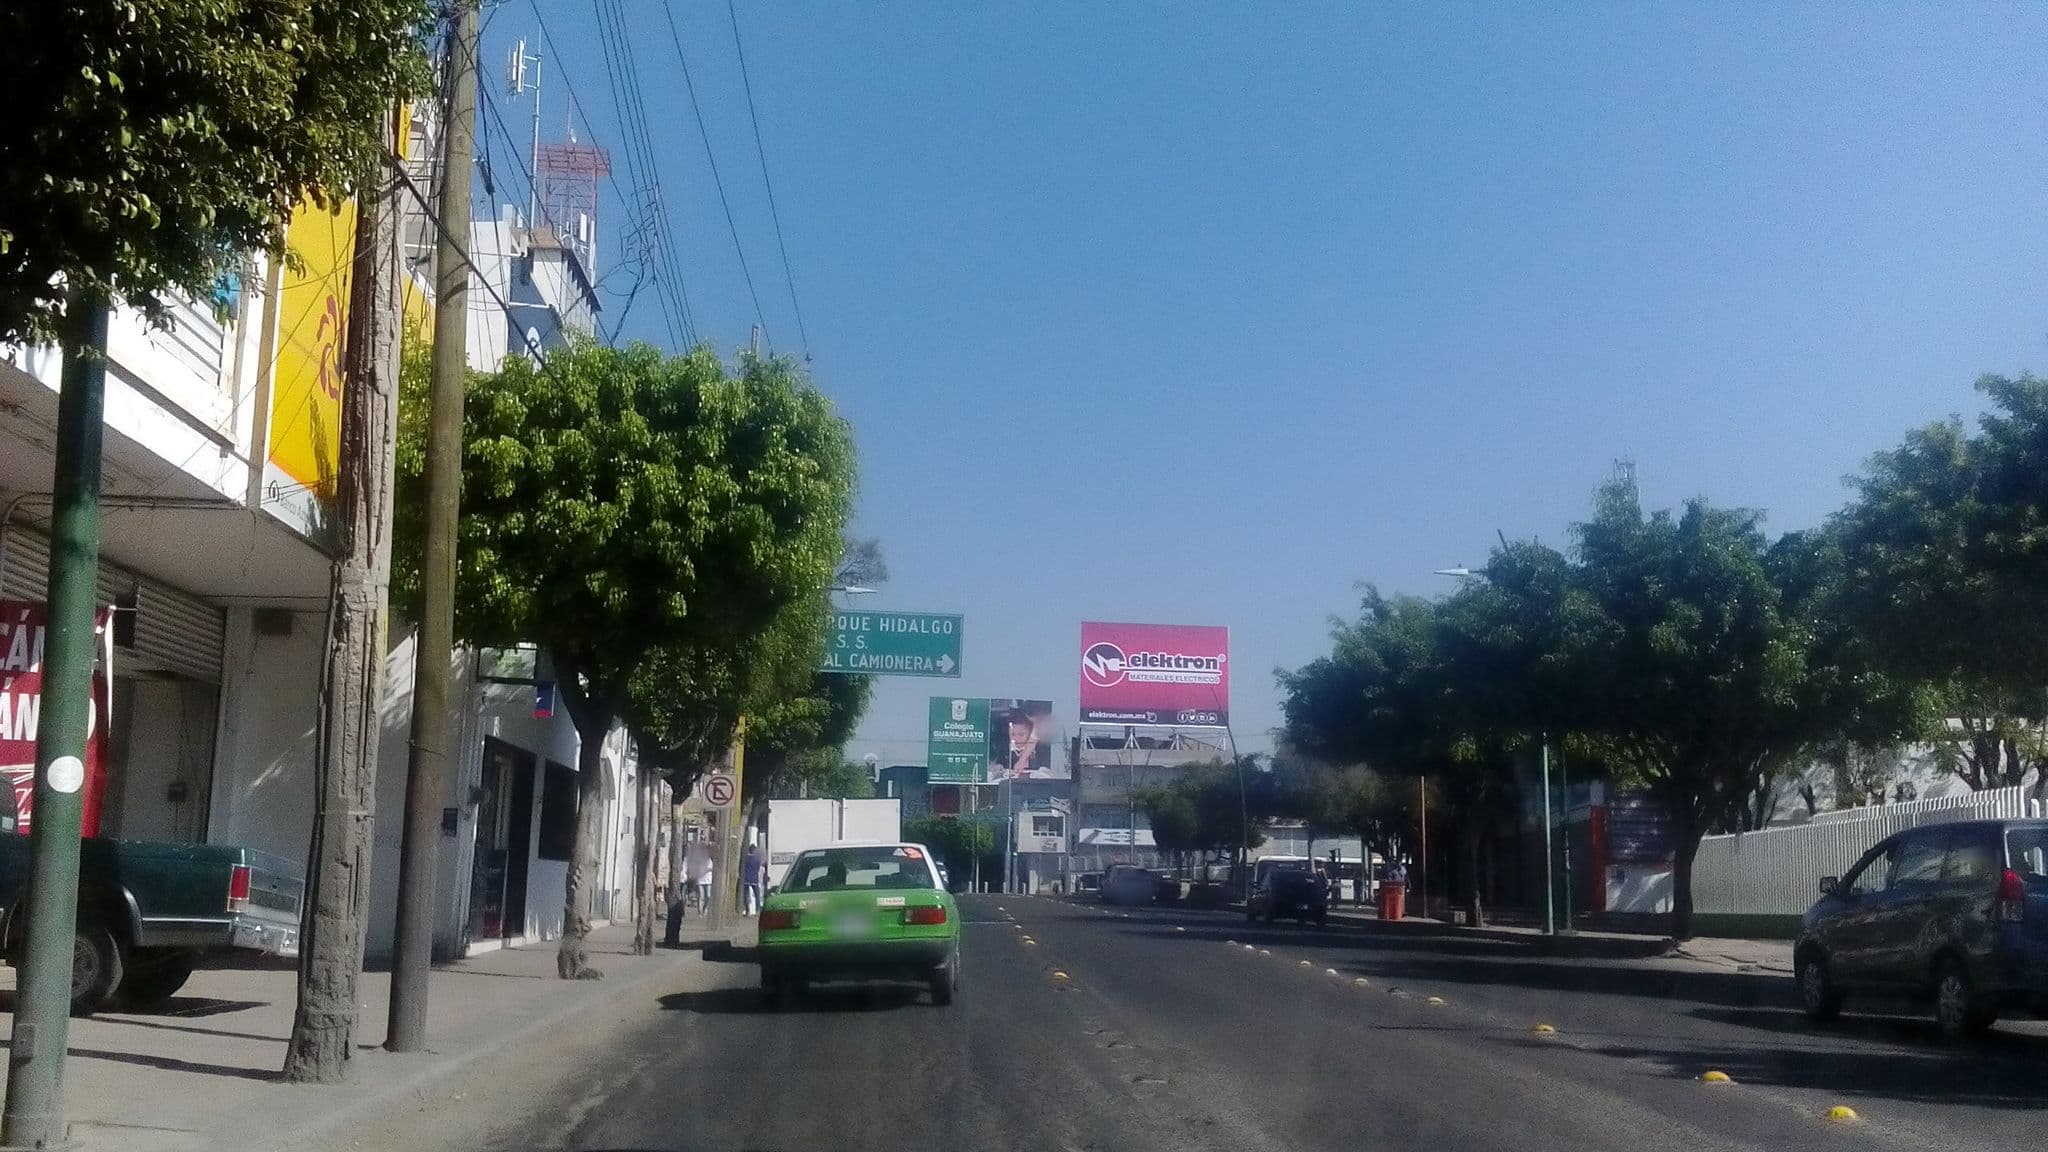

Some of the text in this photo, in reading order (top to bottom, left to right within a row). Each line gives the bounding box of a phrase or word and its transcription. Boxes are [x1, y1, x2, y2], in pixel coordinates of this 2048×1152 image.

[826, 615, 953, 634] RQUE HIDALGO
[823, 653, 934, 670] AL CAMIONERA
[1129, 652, 1219, 670] elektron
[1130, 674, 1174, 682] MATERIALES
[944, 722, 974, 731] Colegio
[933, 730, 984, 738] GUANAJUATO
